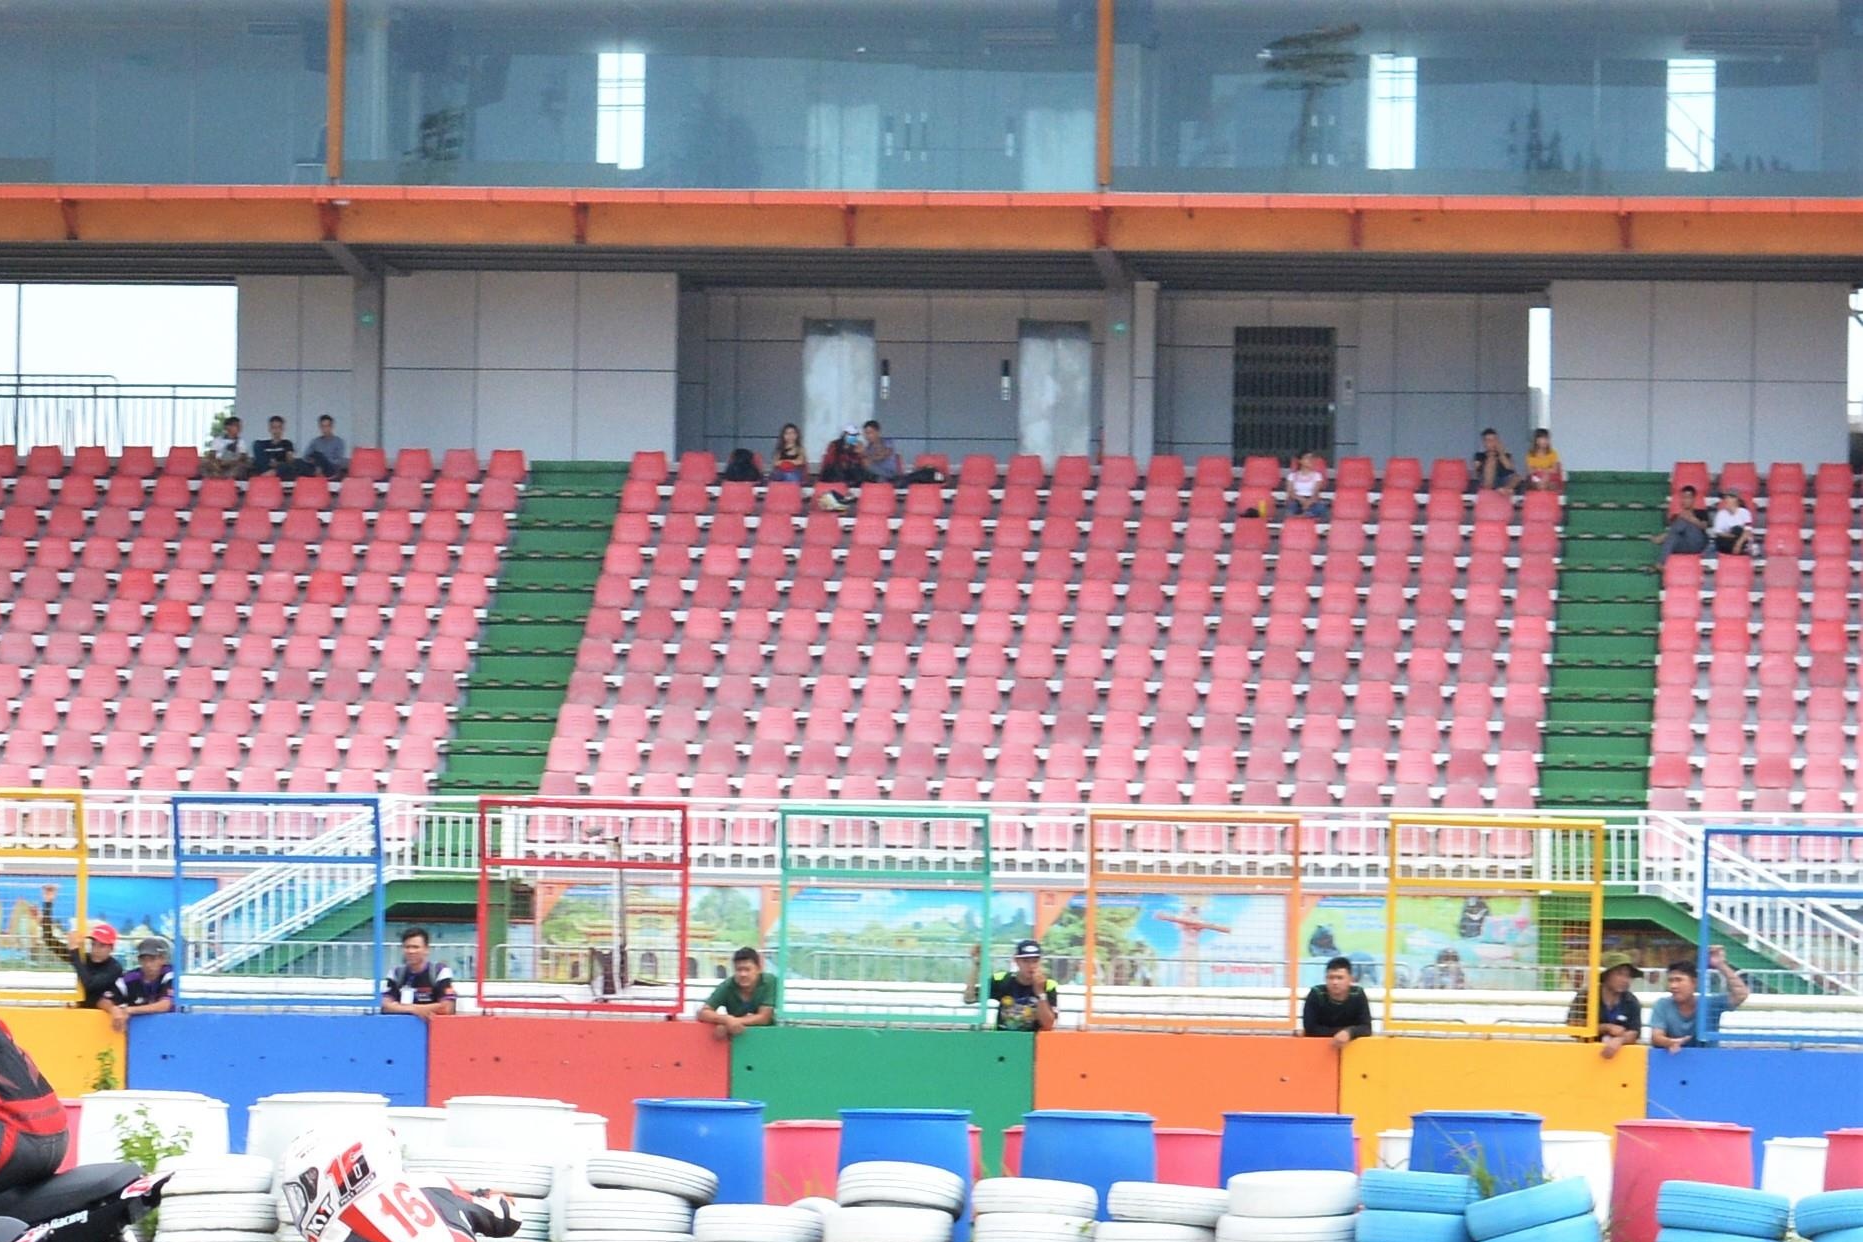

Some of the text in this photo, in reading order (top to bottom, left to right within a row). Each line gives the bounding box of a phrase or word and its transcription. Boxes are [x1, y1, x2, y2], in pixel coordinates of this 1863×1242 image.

[325, 1142, 370, 1197] 16
[305, 1191, 334, 1236] KYT
[378, 1182, 435, 1238] 16
